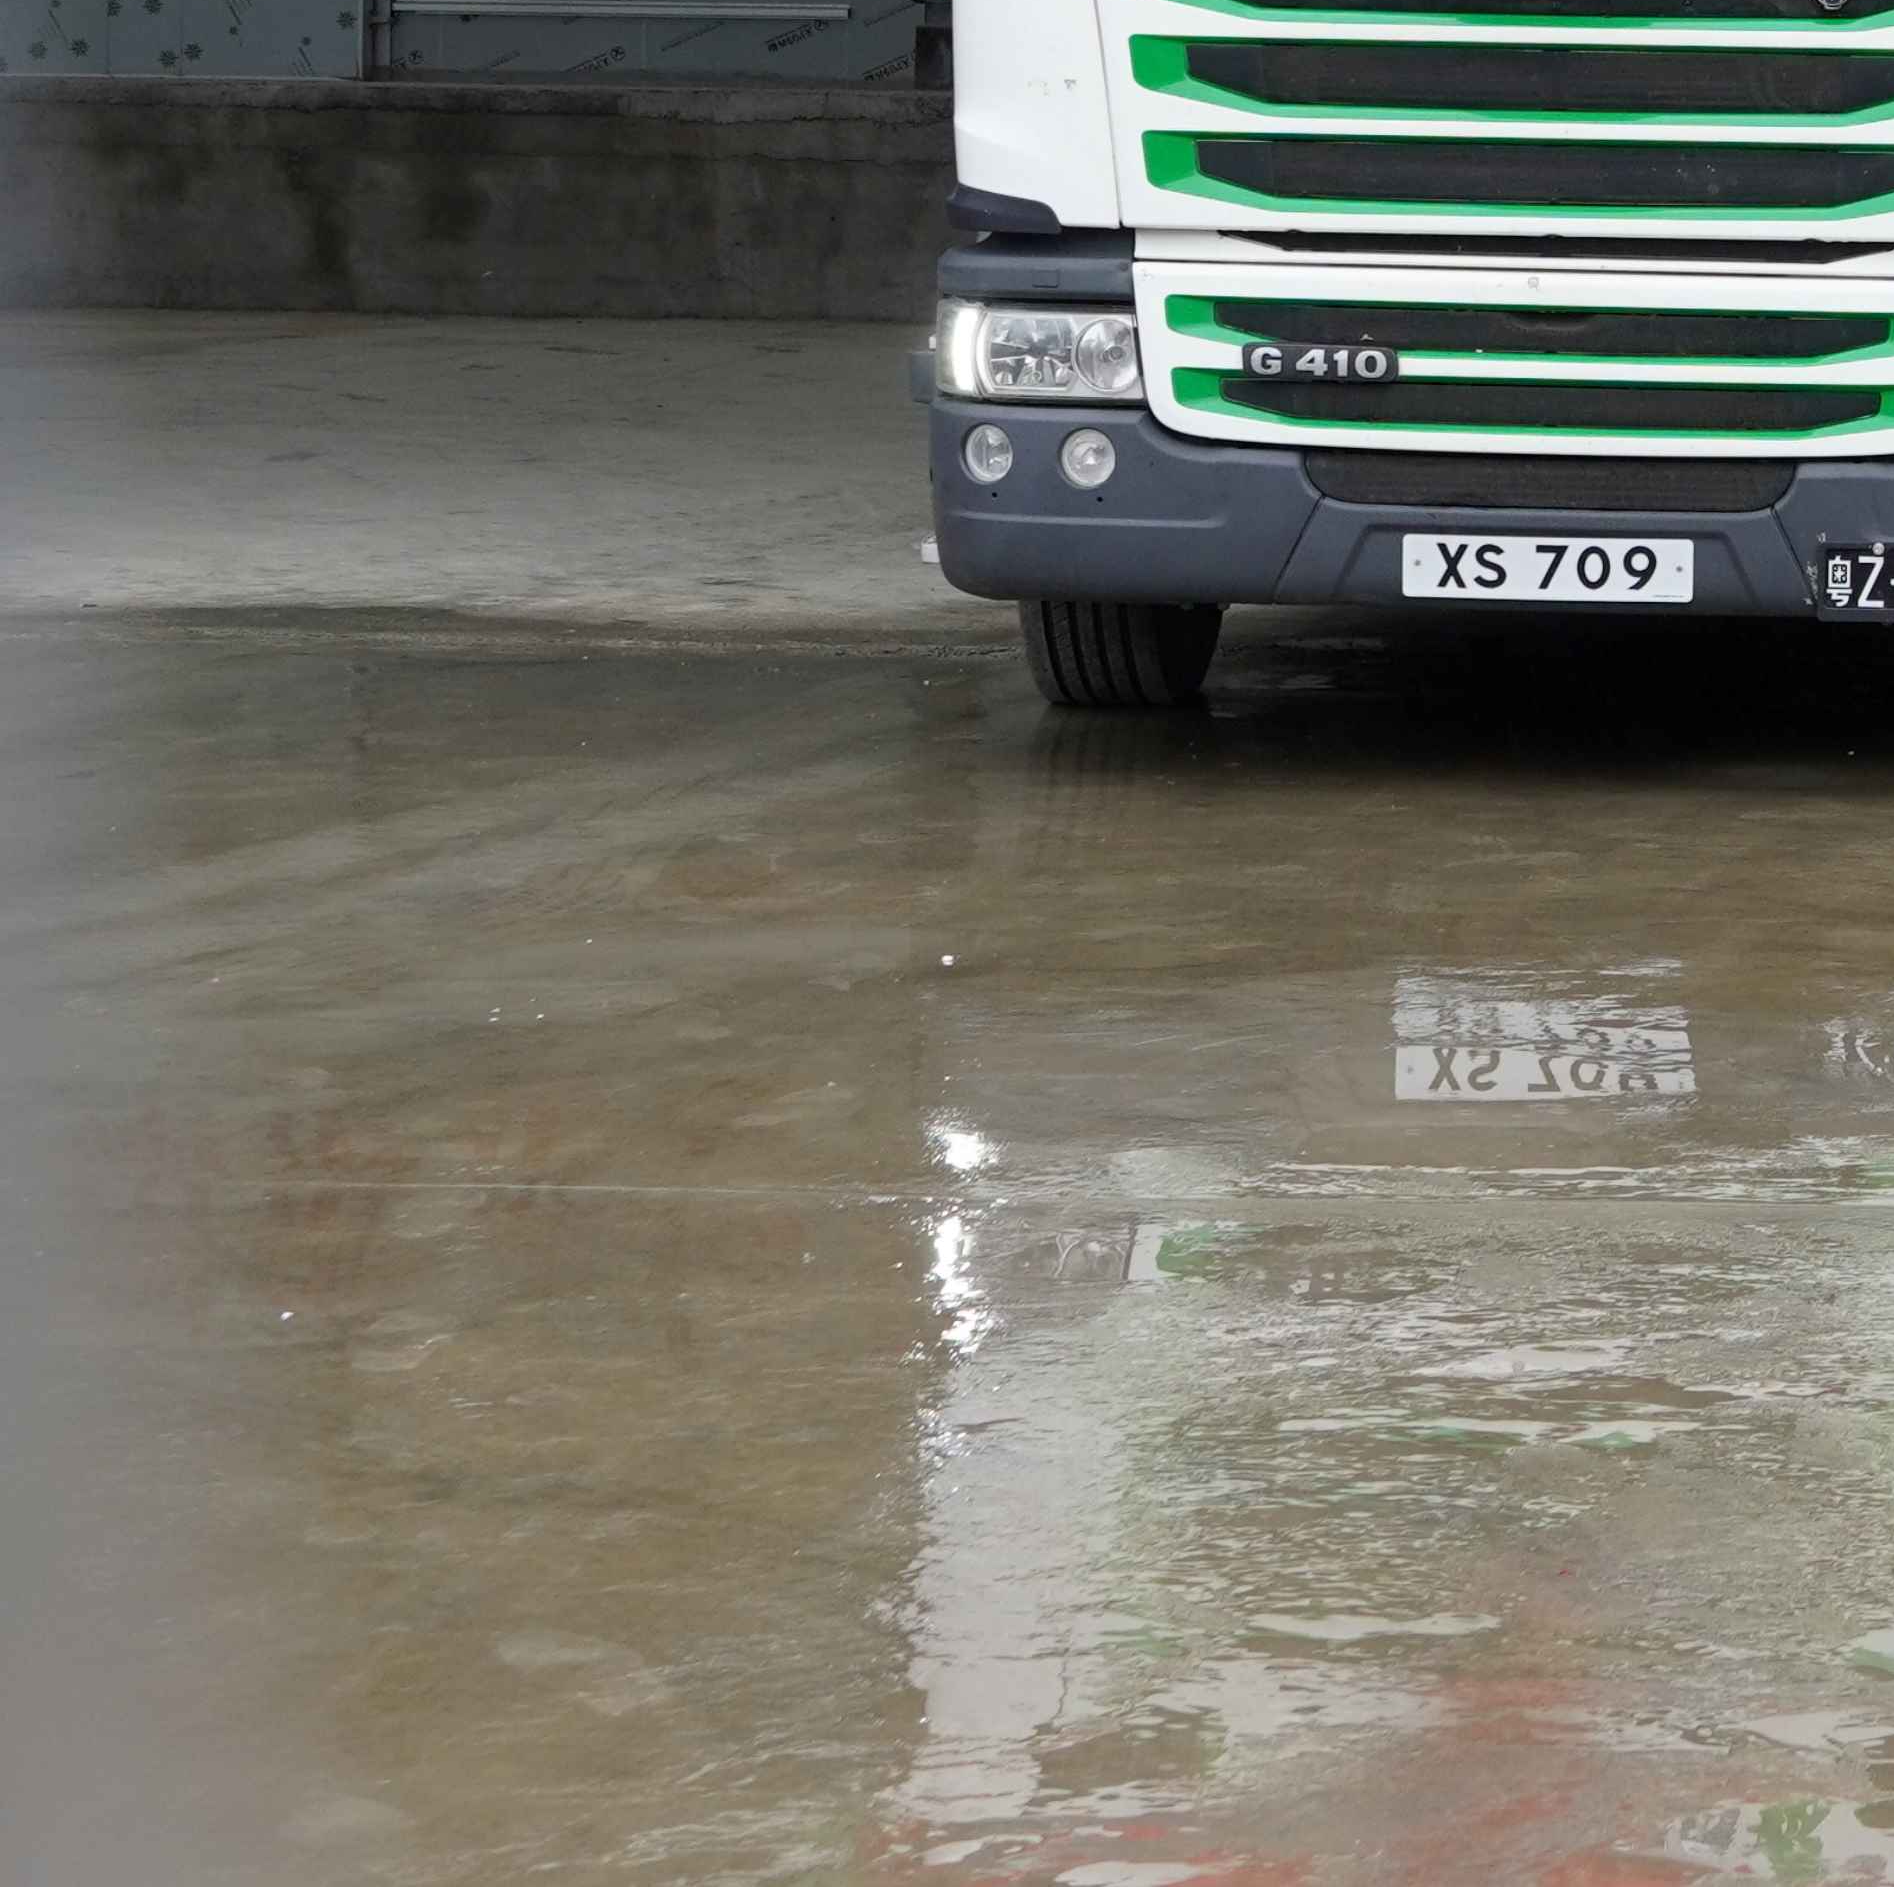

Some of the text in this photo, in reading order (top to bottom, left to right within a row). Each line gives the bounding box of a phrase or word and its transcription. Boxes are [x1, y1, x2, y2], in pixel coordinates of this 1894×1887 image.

[1250, 346, 1388, 379] G 410
[1435, 542, 1658, 591] XS 709
